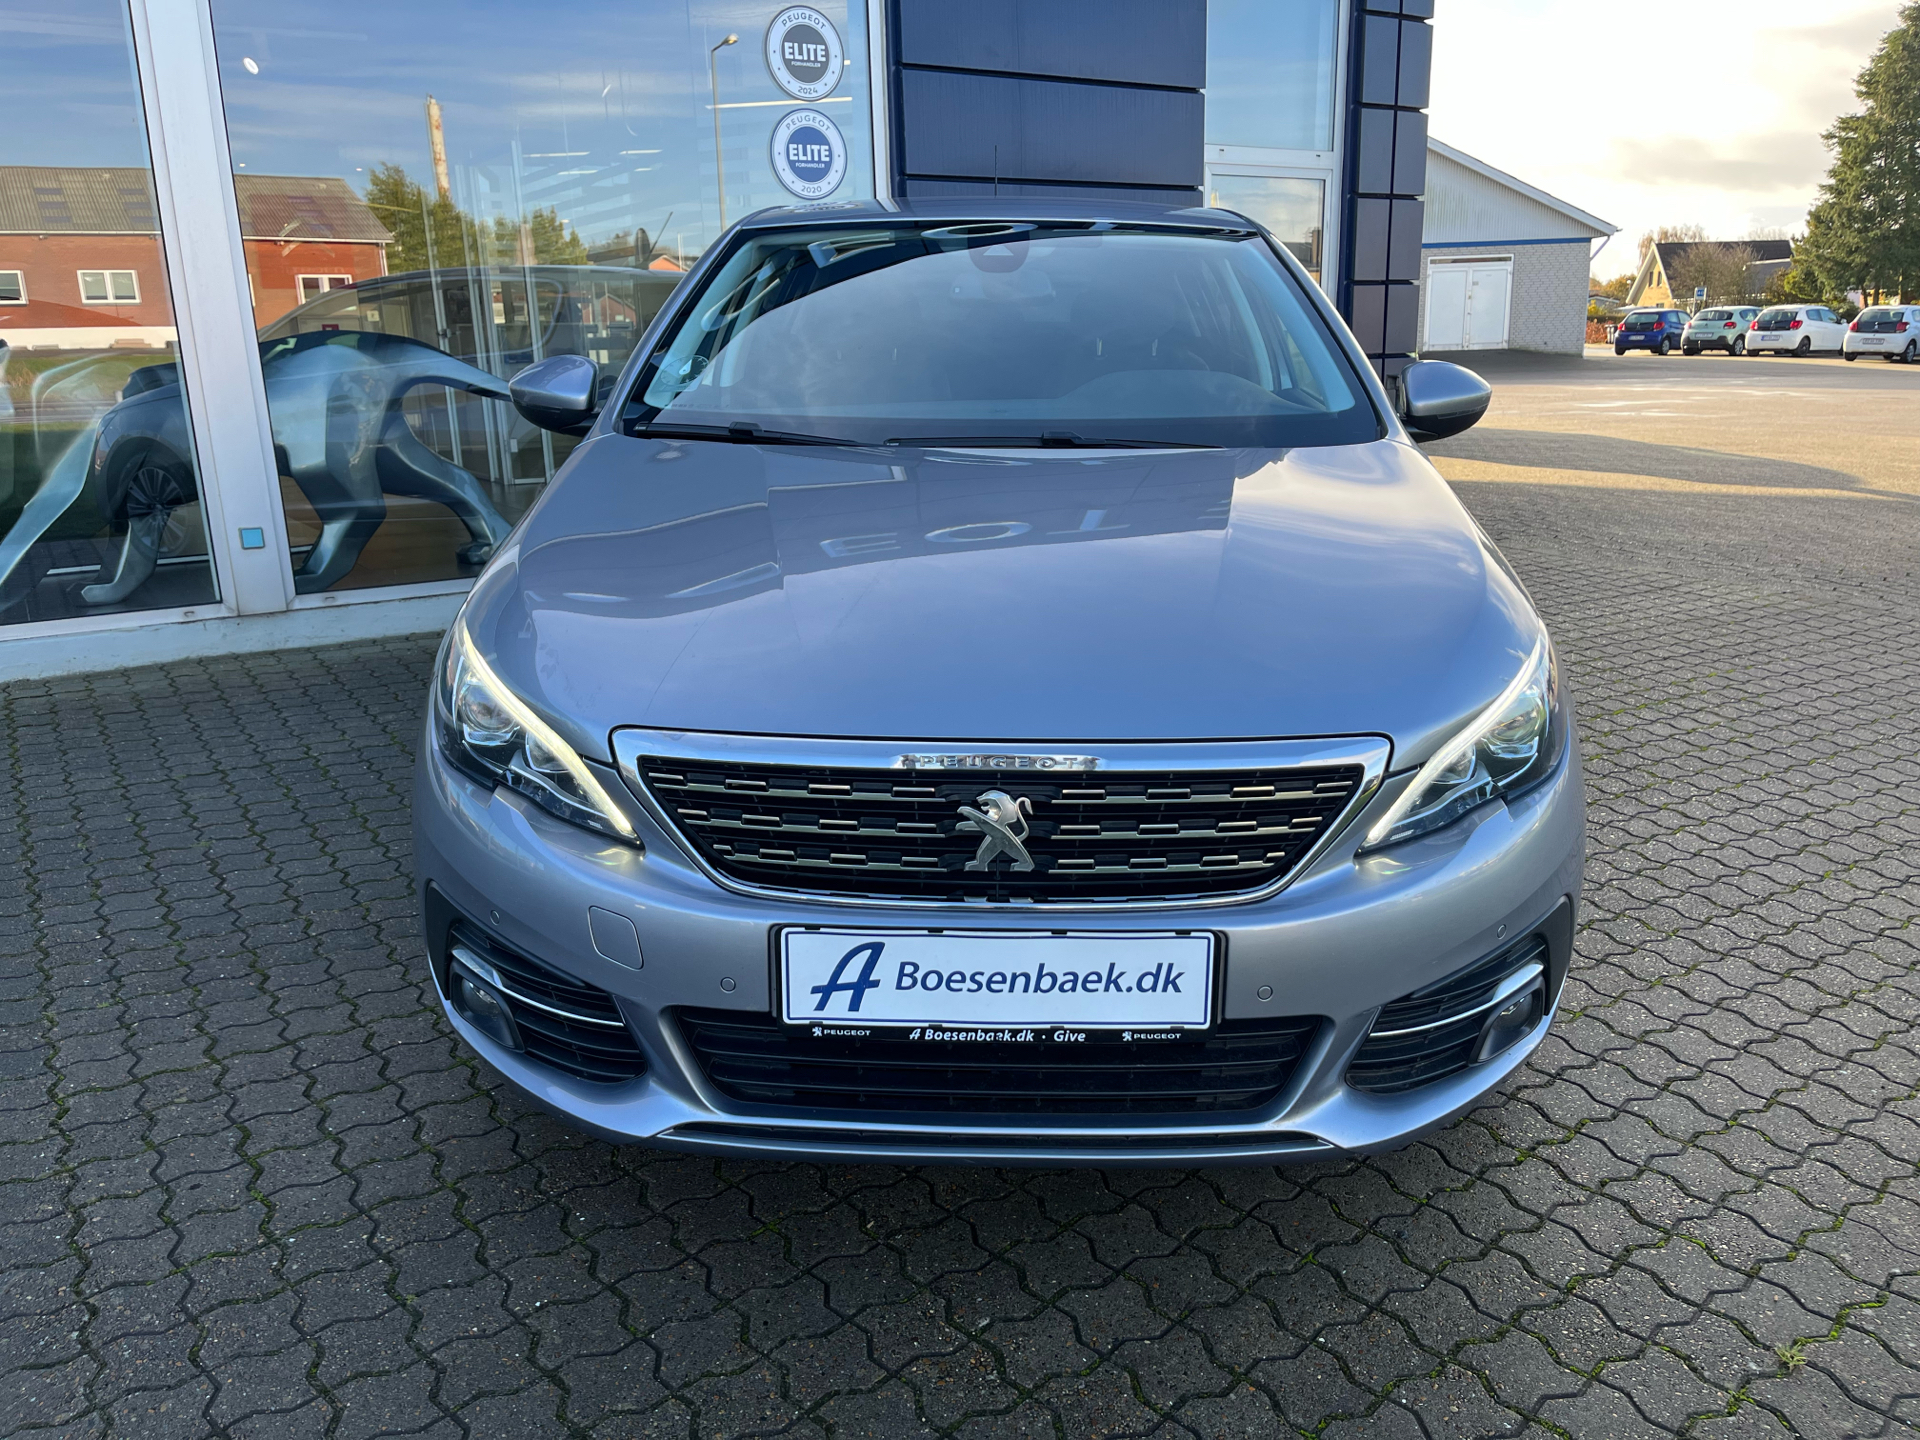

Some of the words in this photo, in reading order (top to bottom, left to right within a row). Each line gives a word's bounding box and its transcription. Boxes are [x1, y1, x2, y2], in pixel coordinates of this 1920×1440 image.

[781, 12, 827, 29] PEUGEOT
[784, 42, 826, 61] ELITE
[798, 86, 818, 95] 2024
[785, 114, 831, 131] PEUGEOT
[788, 144, 830, 161] ELITE
[801, 185, 822, 194] 2020
[919, 755, 1078, 769] PEUGEOT
[810, 941, 886, 1012] A
[895, 961, 1186, 993] Boesenbaek.dk
[1053, 1030, 1086, 1042] Give
